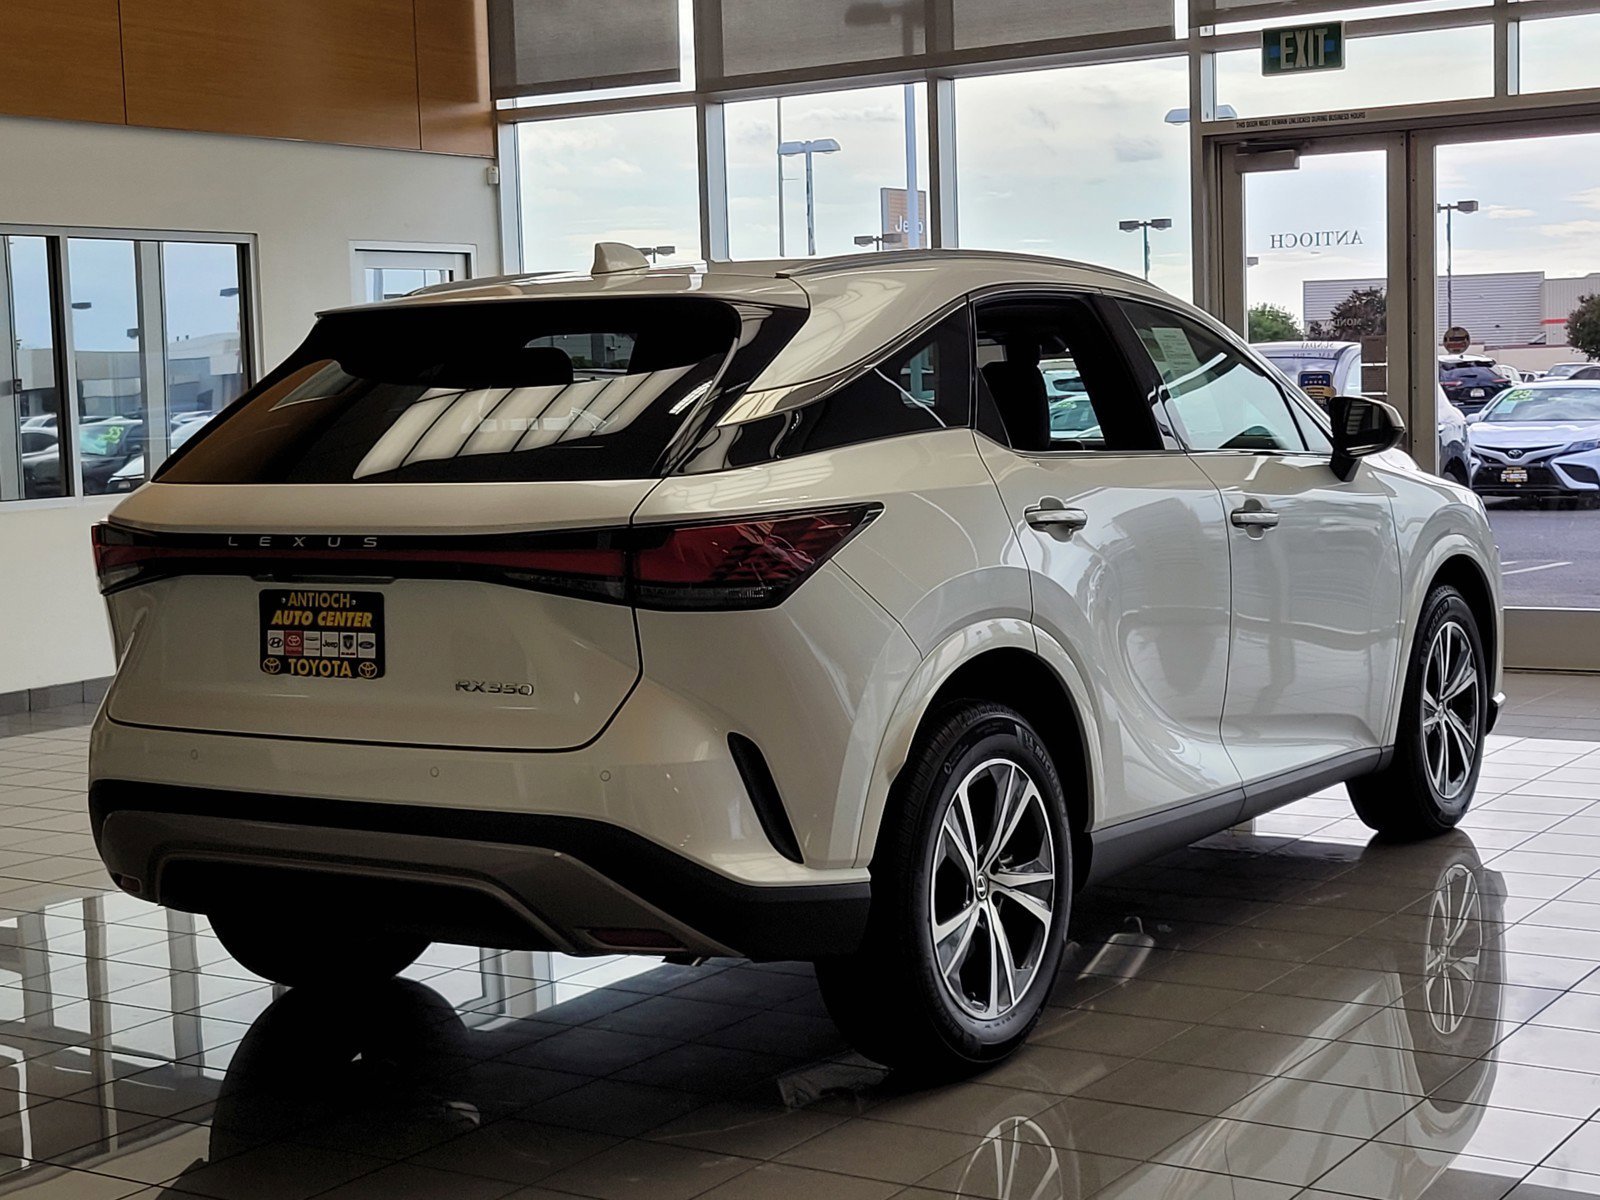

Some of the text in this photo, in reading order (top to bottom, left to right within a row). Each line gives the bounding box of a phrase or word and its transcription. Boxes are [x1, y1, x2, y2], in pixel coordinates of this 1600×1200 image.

[1280, 28, 1328, 69] EXIT
[895, 216, 923, 234] Je
[228, 536, 378, 548] LEXUS
[287, 592, 351, 608] ANTIOCH
[271, 610, 373, 628] AUTO CENTER
[322, 640, 339, 649] Jeep
[288, 658, 352, 677] TOYOTA
[455, 680, 534, 696] RX350
